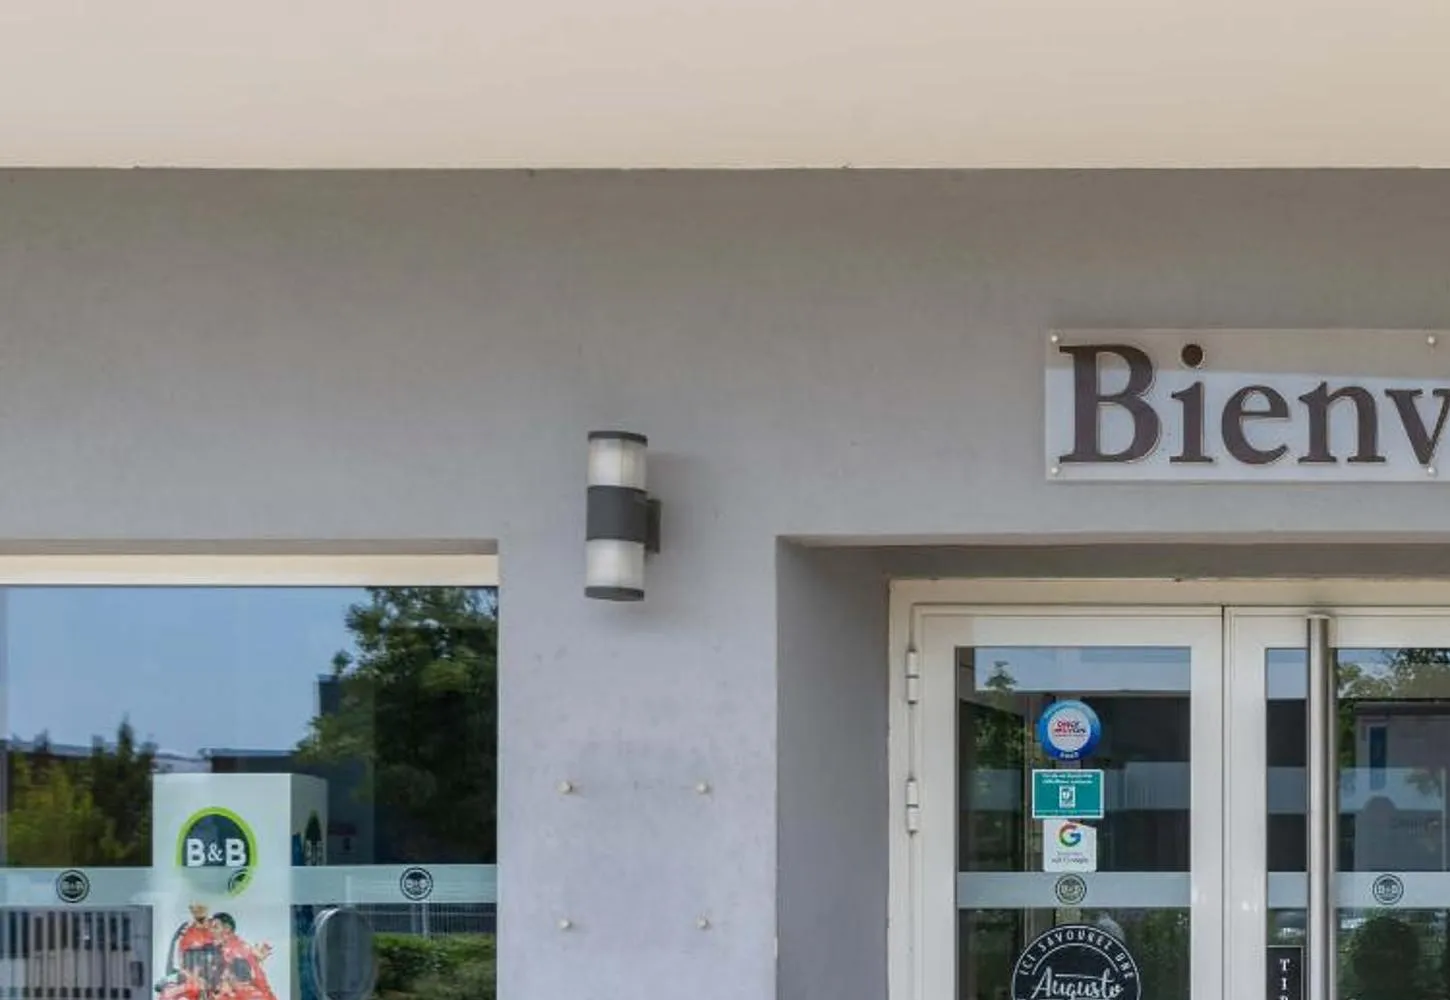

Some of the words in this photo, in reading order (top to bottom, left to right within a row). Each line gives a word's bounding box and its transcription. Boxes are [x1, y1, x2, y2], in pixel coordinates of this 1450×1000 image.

[187, 837, 246, 867] B&B
[1019, 953, 1036, 976] ICI
[1037, 929, 1113, 952] SAVOUREZ
